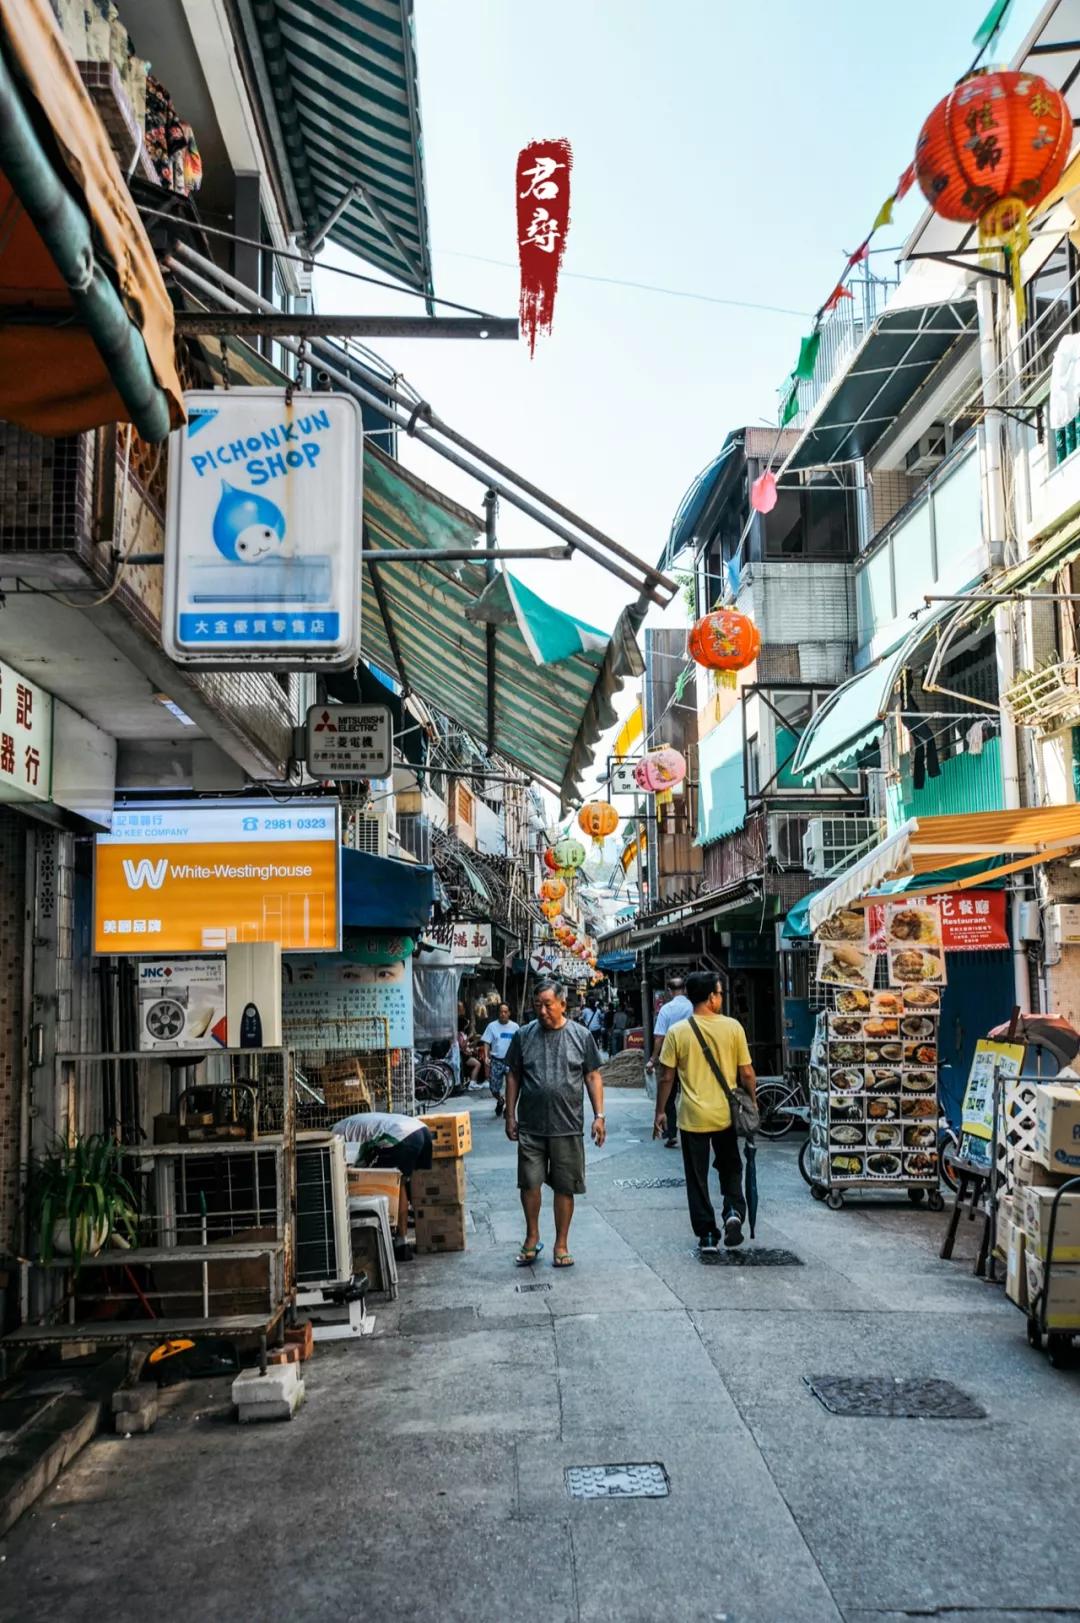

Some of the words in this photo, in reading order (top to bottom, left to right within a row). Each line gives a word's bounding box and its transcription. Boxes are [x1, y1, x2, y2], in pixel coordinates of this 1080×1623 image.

[191, 409, 331, 477] PICHONKUN
[246, 442, 320, 486] SHOP
[338, 716, 384, 724] MITSUBISHI
[338, 724, 378, 732] ELECTRIC
[324, 735, 374, 749] 三菱電機
[265, 819, 292, 830] 2981
[297, 817, 327, 829] 0323
[125, 829, 143, 837] KEE
[144, 828, 189, 837] COMPANY
[170, 863, 313, 881] White-Westinghouse
[942, 918, 986, 926] Restaurant
[140, 967, 164, 978] JNC
